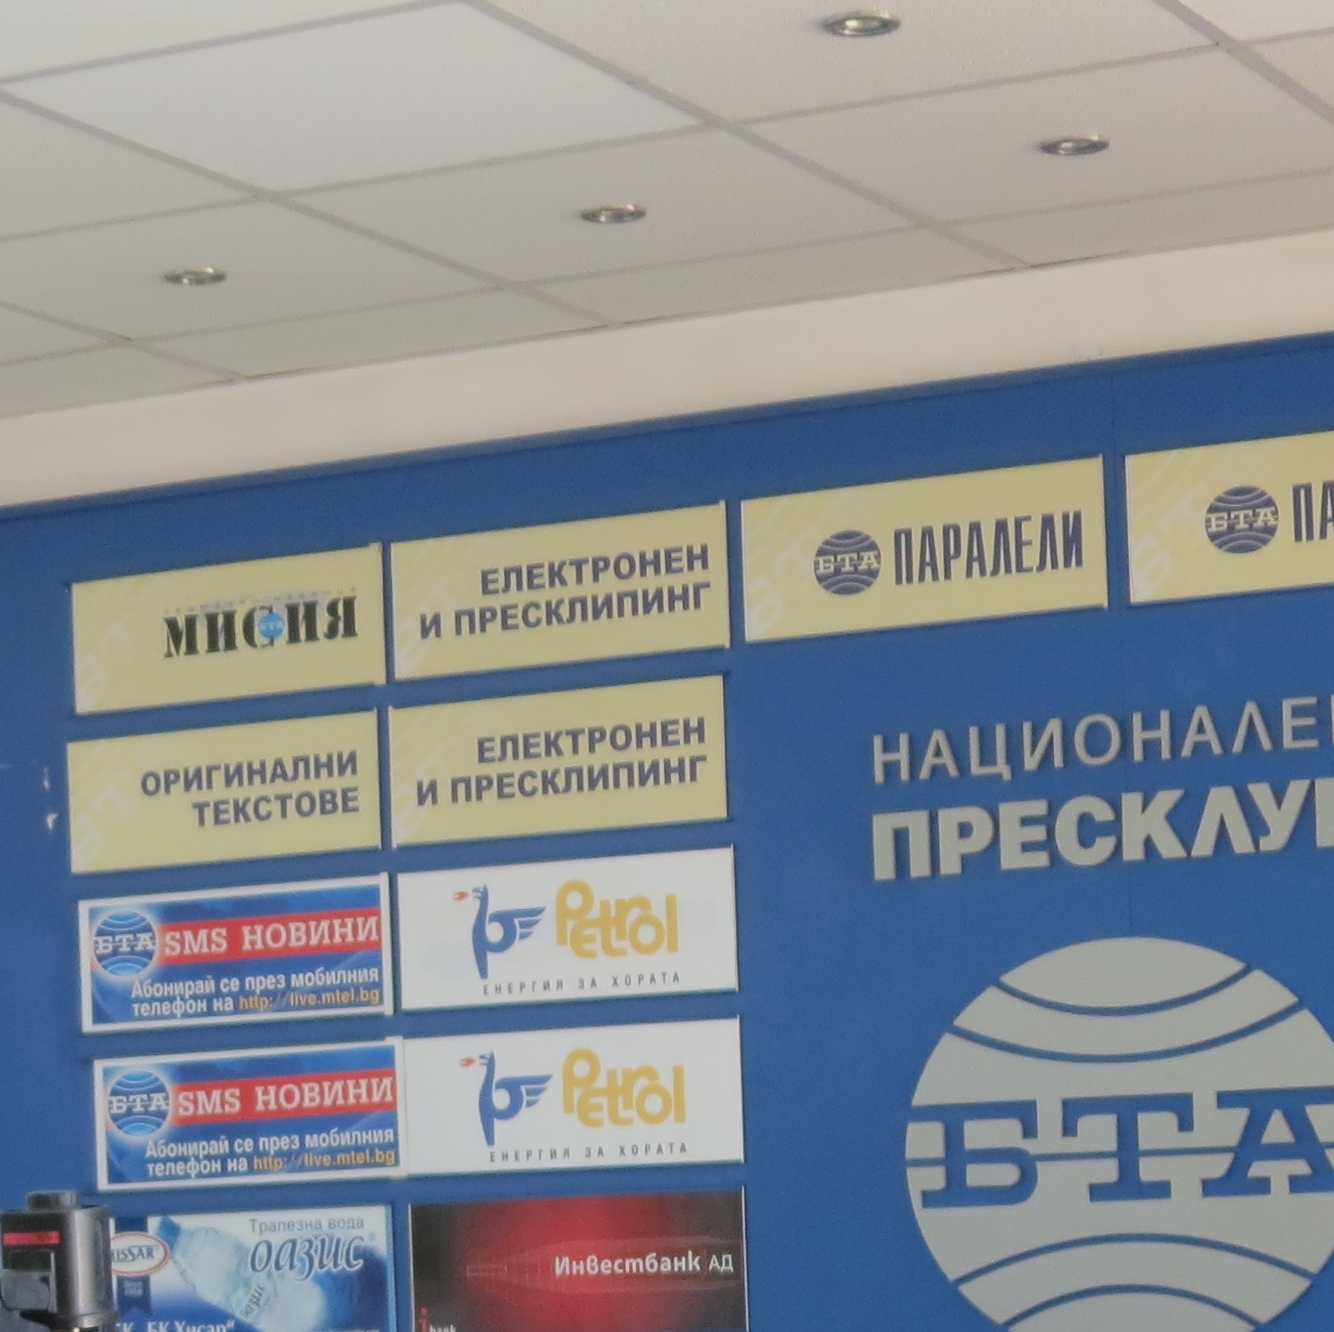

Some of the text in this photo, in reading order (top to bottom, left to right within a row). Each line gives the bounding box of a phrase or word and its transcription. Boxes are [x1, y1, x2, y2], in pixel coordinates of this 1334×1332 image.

[1204, 506, 1280, 534] БТА
[813, 550, 882, 576] БТА
[893, 510, 1083, 585] ПАРАЛЕЛИ
[480, 543, 710, 597] ЕЛЕКТРОНЕН
[163, 596, 359, 658] МИСИЯ
[420, 581, 712, 640] И ПРЕСКЛИПИНГ
[477, 717, 706, 764] ЕЛЕКТРОНЕН
[140, 751, 358, 797] ОРИГИНАЛНИ
[416, 755, 707, 806] И ПРЕСКЛИПИНГ
[191, 786, 360, 828] ТЕКСТОВЕ
[166, 916, 379, 956] SMS НОВИНИ
[555, 879, 679, 959] Petrol
[92, 932, 156, 955] БТА
[131, 967, 378, 999] Абонирай се през мобилния
[483, 971, 681, 996] ЕНЕРГИЯ ЗА ХОРАТА
[132, 999, 210, 1019] телефон
[214, 997, 234, 1012] на
[107, 1092, 170, 1115] БТА
[178, 1076, 394, 1116] SMS НОВИНИ
[562, 1047, 686, 1128] Petrol
[145, 1128, 395, 1158] Абонирай се през мобилния
[489, 1141, 688, 1163] ЕНЕРГИЯ ЗА ХОРАТА
[146, 1159, 221, 1179] телефон
[227, 1158, 247, 1171] на
[250, 1216, 364, 1234] Трапезна вода
[248, 1234, 365, 1282] оазис
[554, 1250, 734, 1276] Инвестбанк АД
